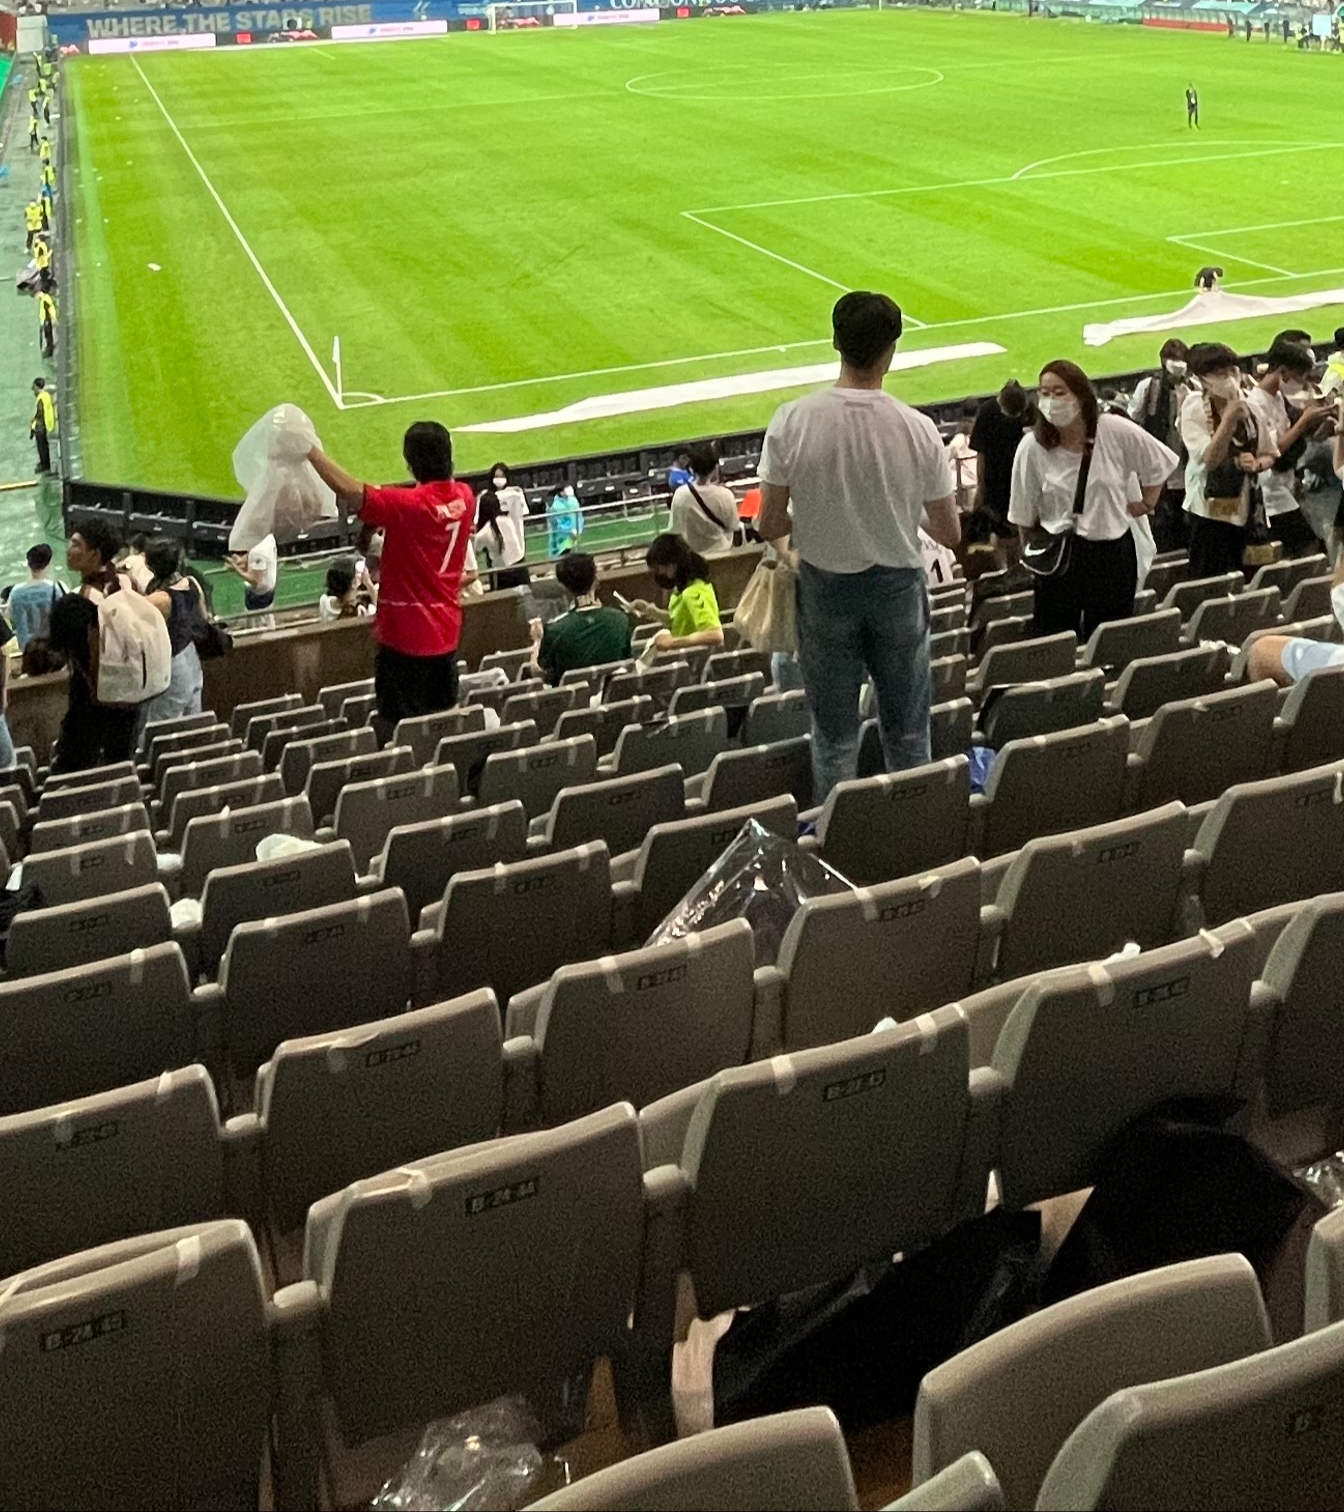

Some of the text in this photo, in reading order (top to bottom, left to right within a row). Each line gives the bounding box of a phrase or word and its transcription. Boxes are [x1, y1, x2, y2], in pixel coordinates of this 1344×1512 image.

[86, 3, 372, 39] WHERE THE STARS RISE
[439, 520, 461, 574] 7
